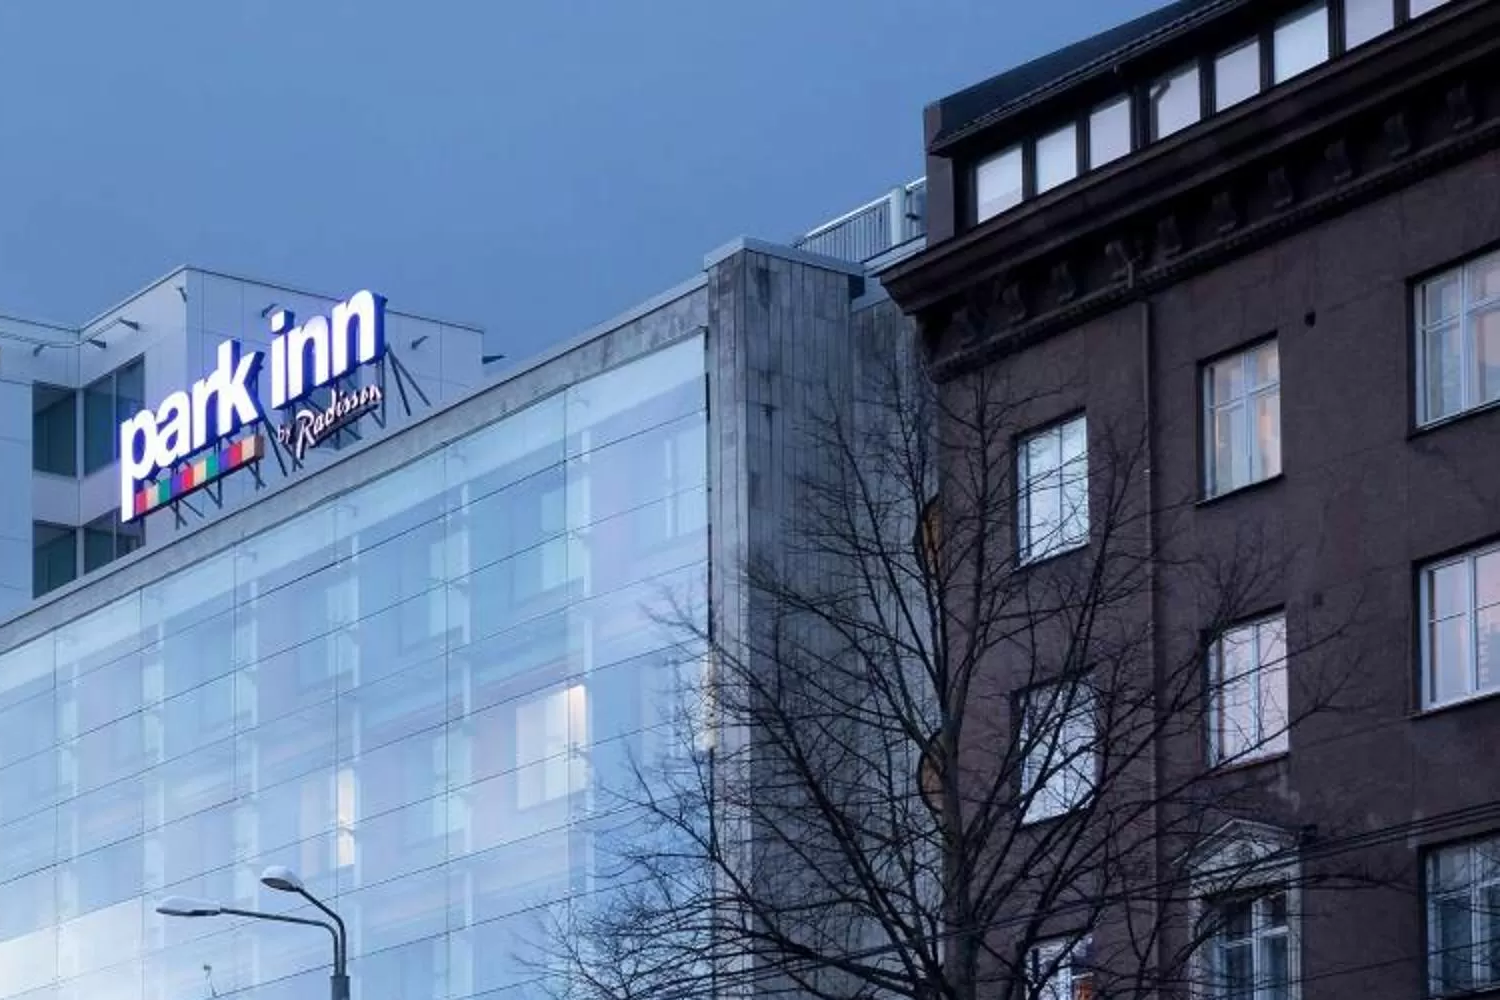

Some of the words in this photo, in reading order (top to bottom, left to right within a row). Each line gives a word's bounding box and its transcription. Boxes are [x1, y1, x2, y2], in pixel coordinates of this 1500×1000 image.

[121, 339, 263, 523] park
[271, 289, 386, 410] inn
[277, 424, 294, 446] by
[296, 384, 382, 460] Radisson
